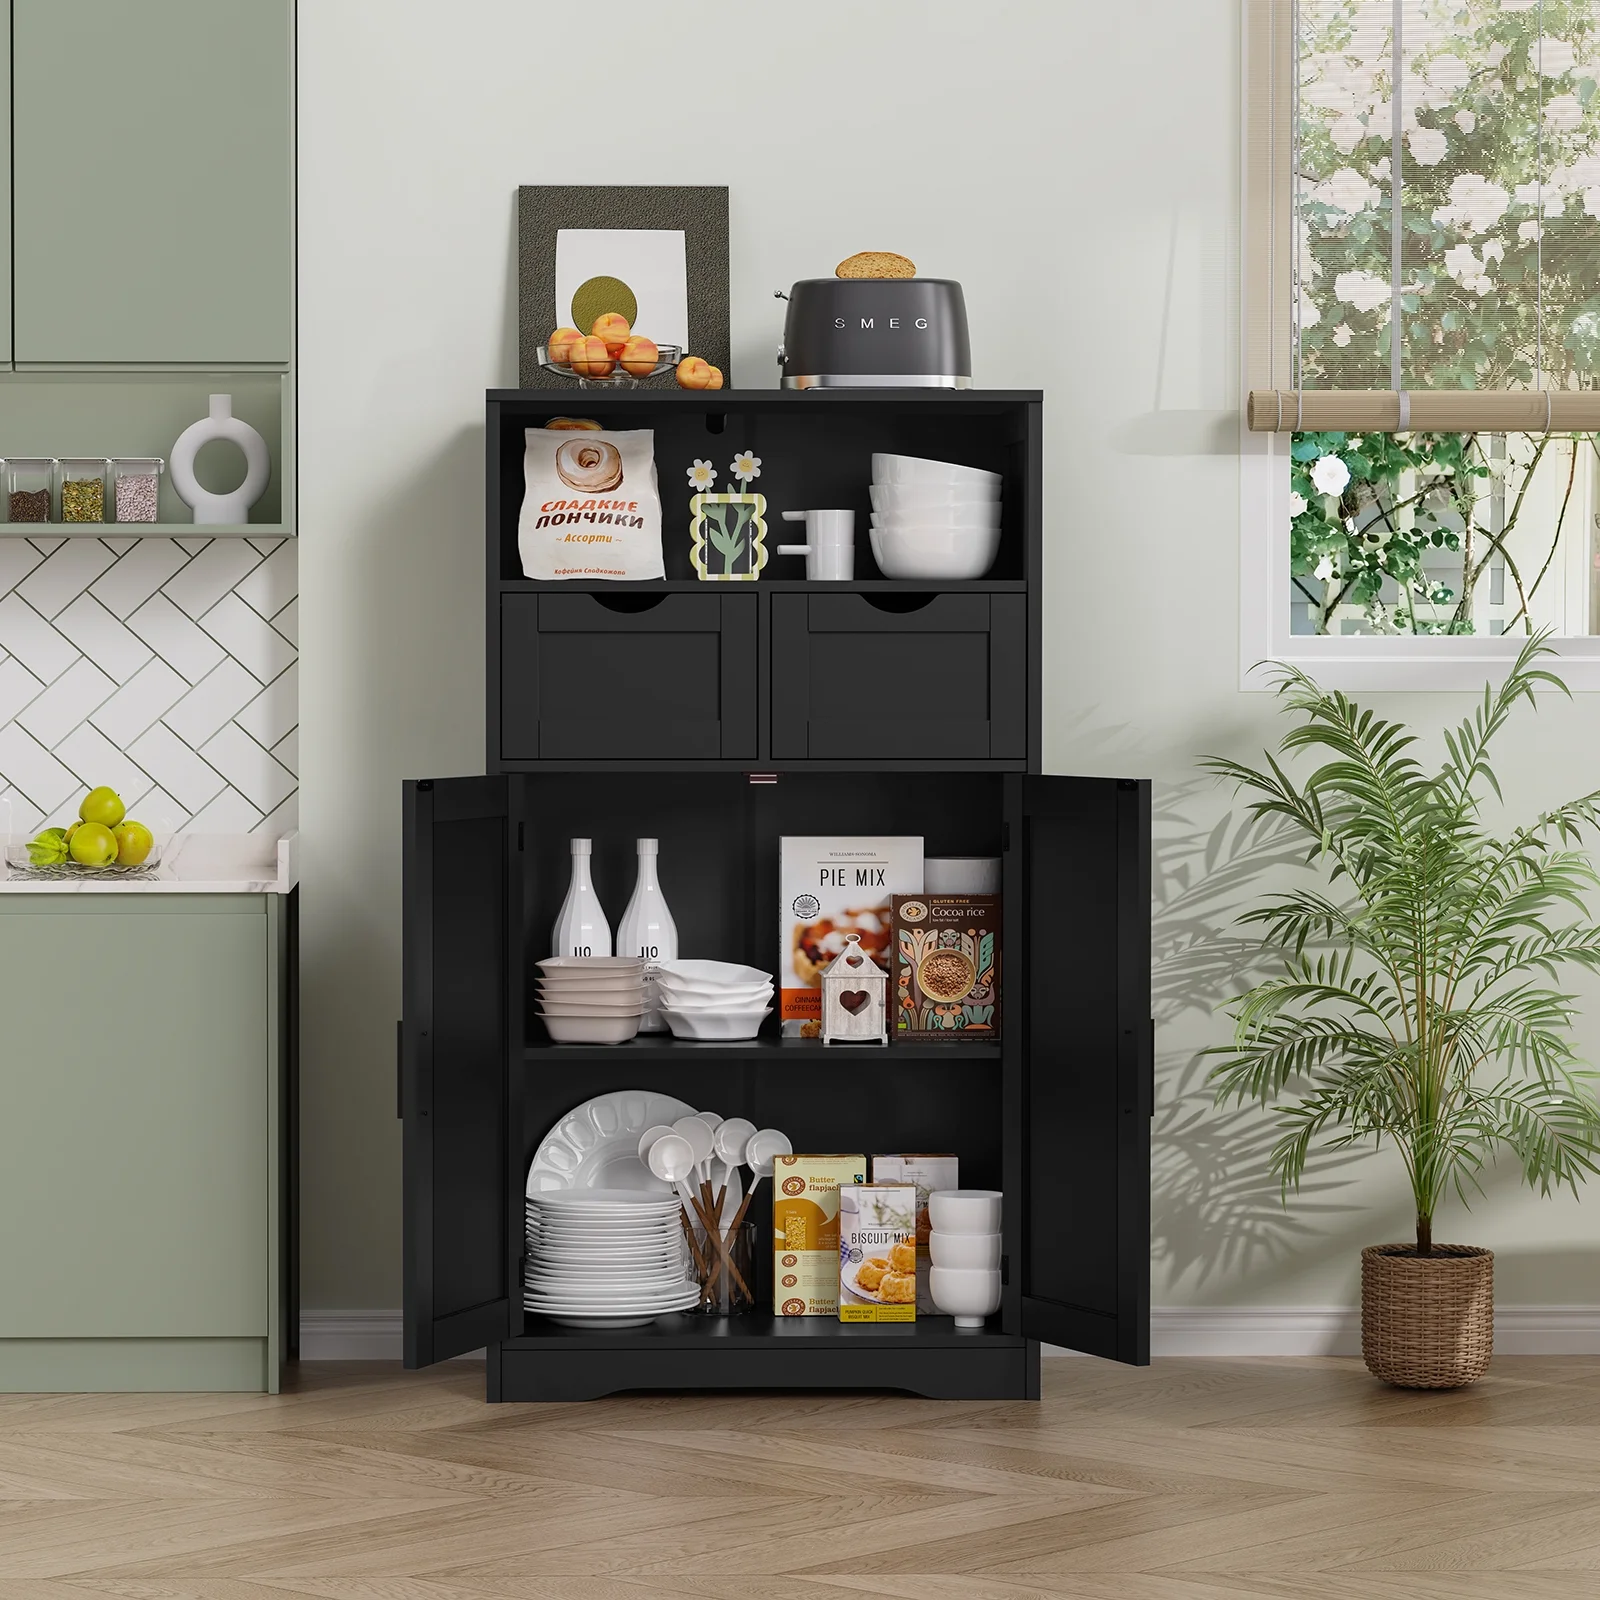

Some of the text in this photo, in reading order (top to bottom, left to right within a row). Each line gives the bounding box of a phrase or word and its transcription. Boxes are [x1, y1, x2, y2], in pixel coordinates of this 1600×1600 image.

[834, 318, 928, 329] SMEG
[540, 499, 639, 513] СЛАДКИЕ
[535, 512, 644, 530] ПОНЧИКИ
[564, 533, 613, 544] Ассорти
[820, 868, 886, 887] PIE MIX
[932, 906, 986, 917] Cocoa rice
[851, 1232, 911, 1244] BISCUIT MIX
